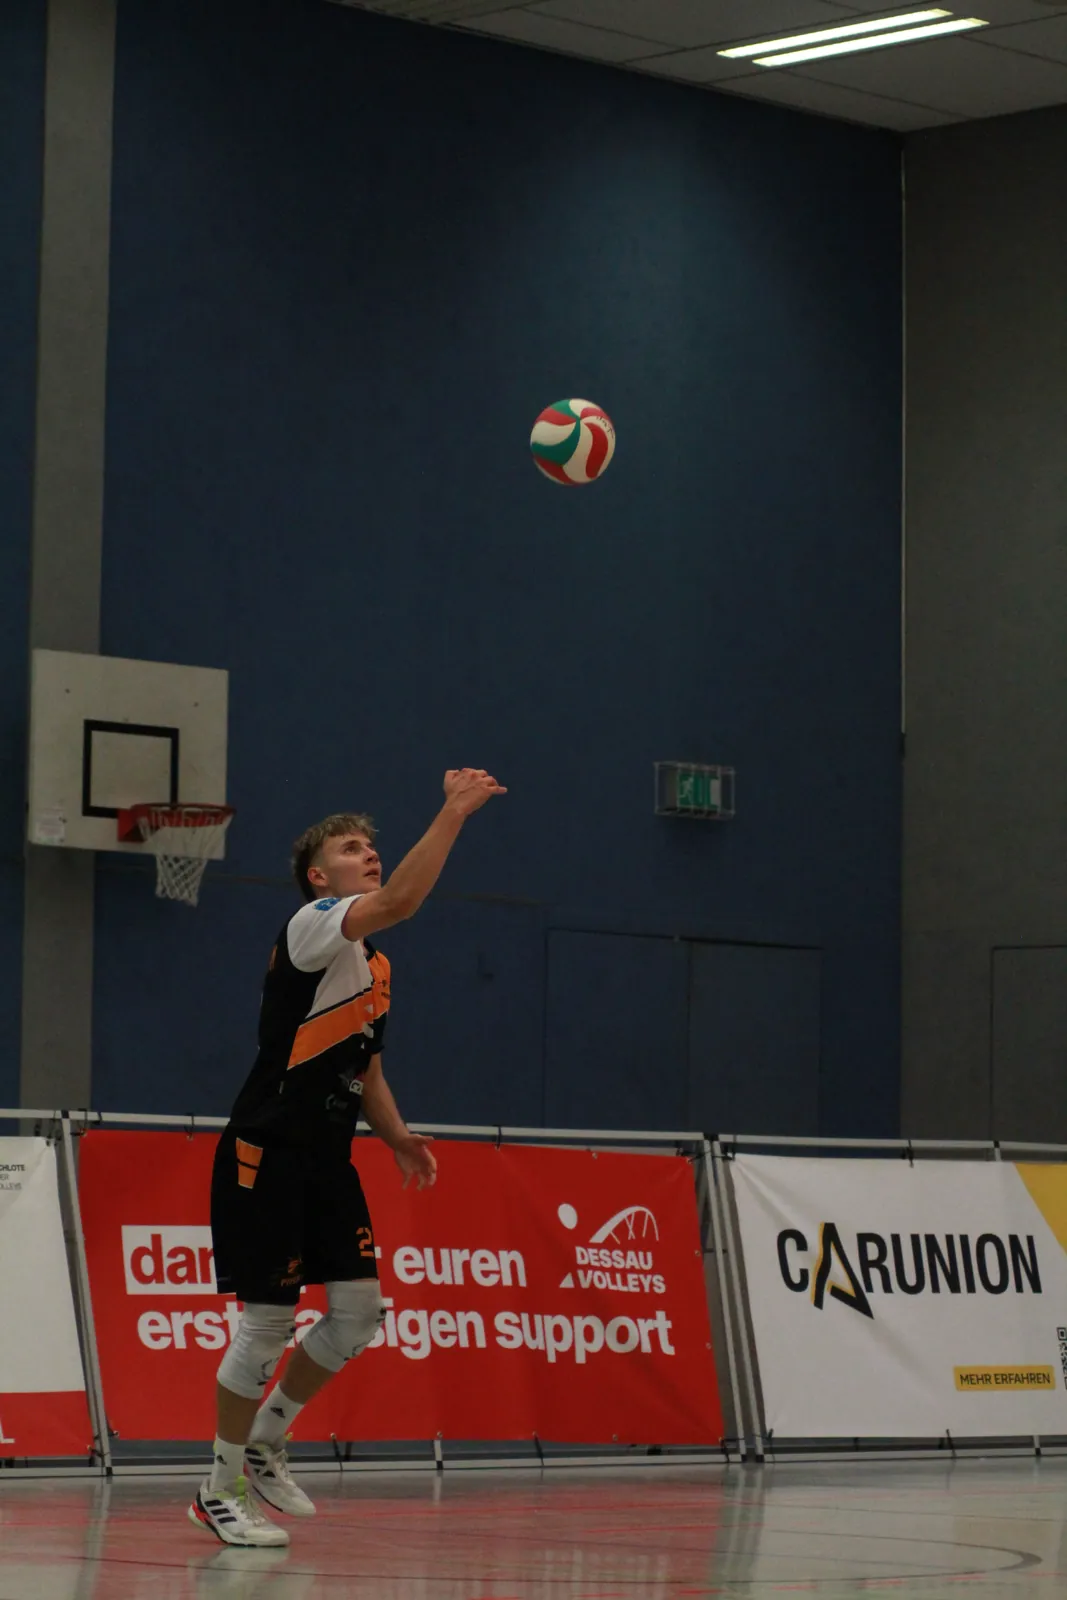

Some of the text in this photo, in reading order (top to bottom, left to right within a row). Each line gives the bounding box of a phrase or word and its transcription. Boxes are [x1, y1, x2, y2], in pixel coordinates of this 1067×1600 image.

[355, 1227, 375, 1257] 2
[393, 1246, 527, 1288] euren
[575, 1246, 654, 1271] DESSAU
[777, 1222, 1043, 1320] CARUNION
[576, 1269, 667, 1294] VOLLEYS
[494, 1310, 676, 1365] support
[959, 1372, 1051, 1386] MEHR ERFAHREN
